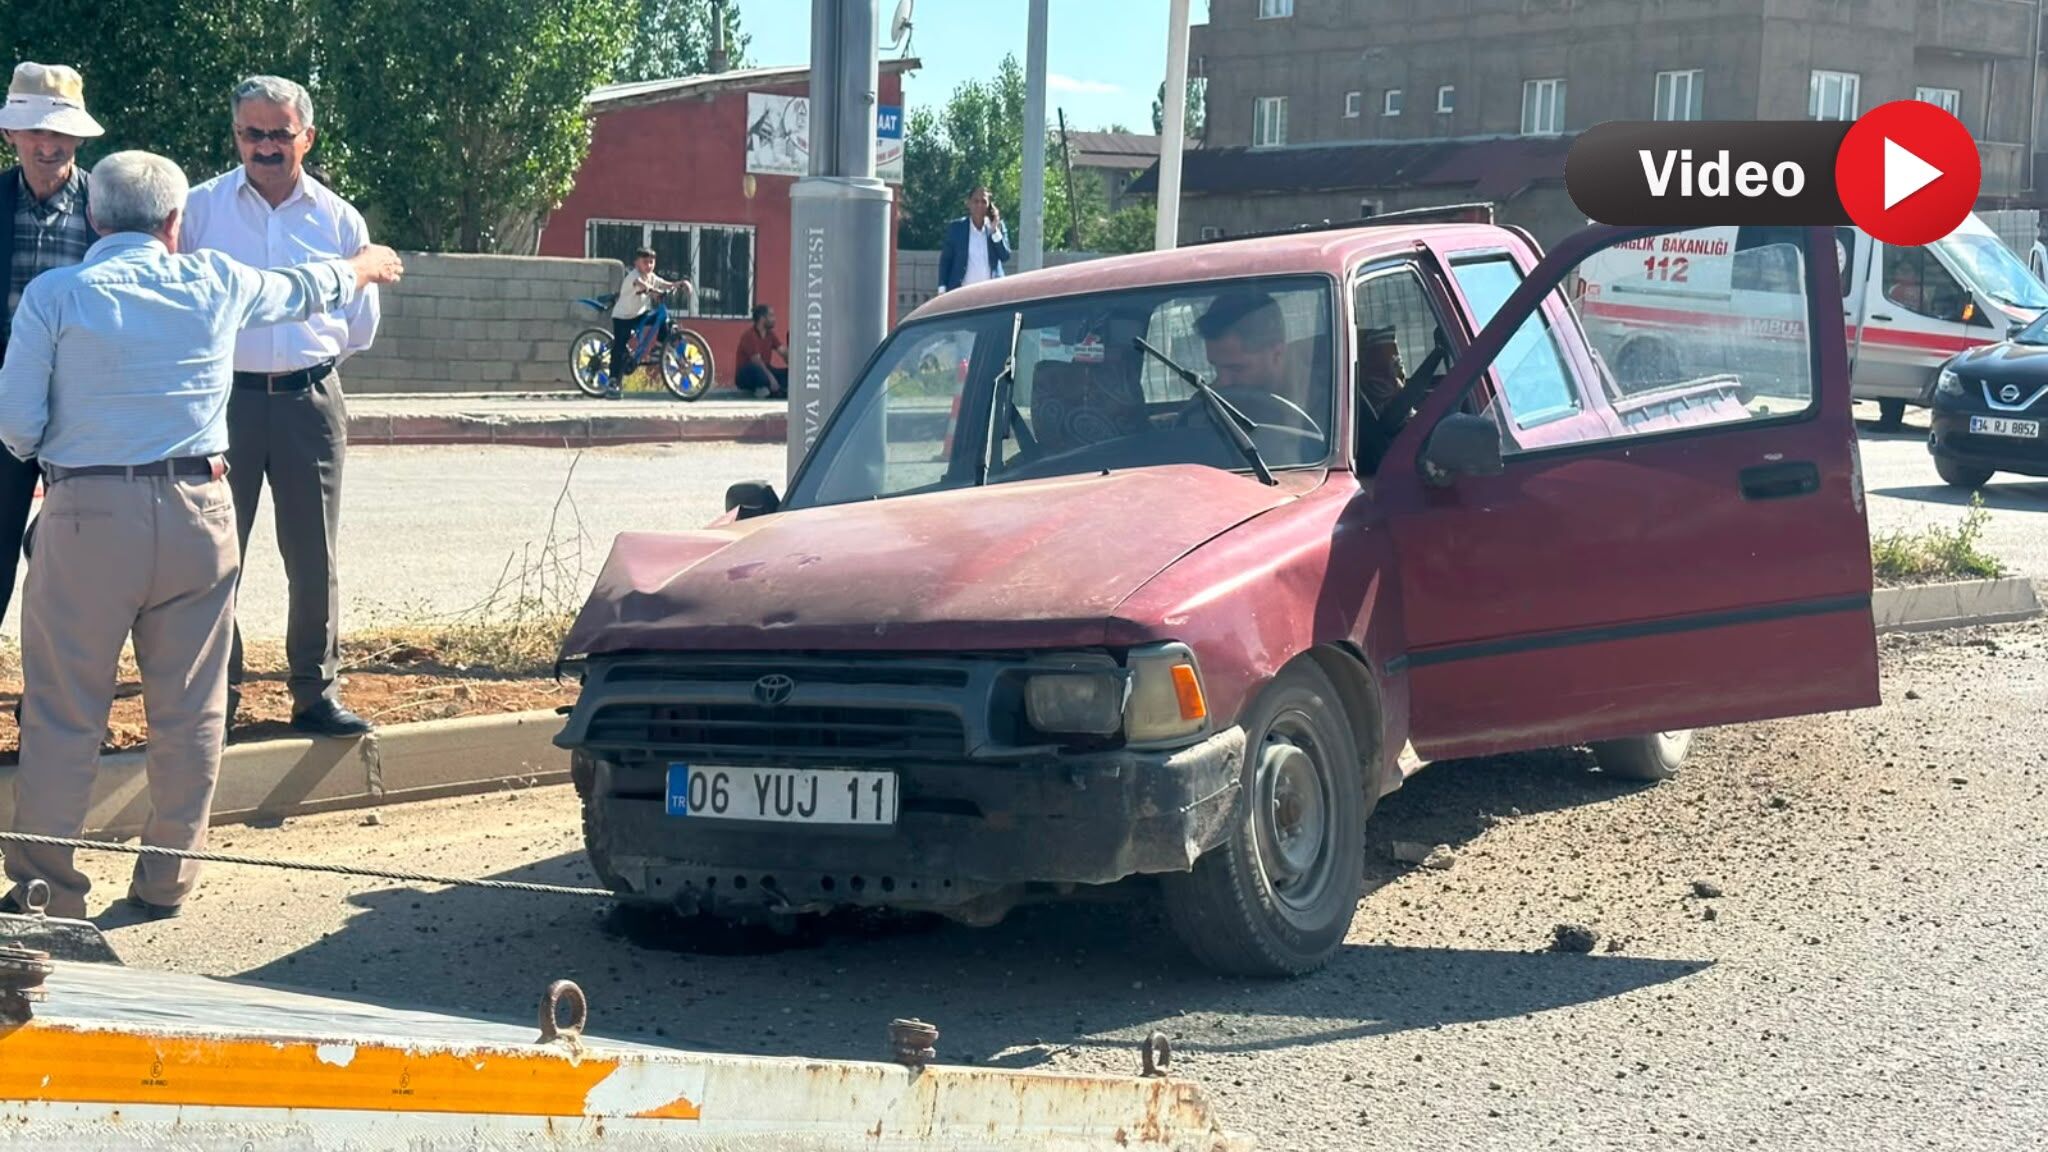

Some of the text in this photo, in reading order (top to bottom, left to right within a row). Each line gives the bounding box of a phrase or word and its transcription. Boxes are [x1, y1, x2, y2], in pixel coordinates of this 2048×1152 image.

[1661, 238, 1729, 256] BAKANLIĞI
[1644, 255, 1689, 283] 112
[805, 227, 824, 390] BELEDİYESİ
[1994, 420, 2007, 434] RJ
[672, 772, 883, 821] TR 06 YUJ 11
